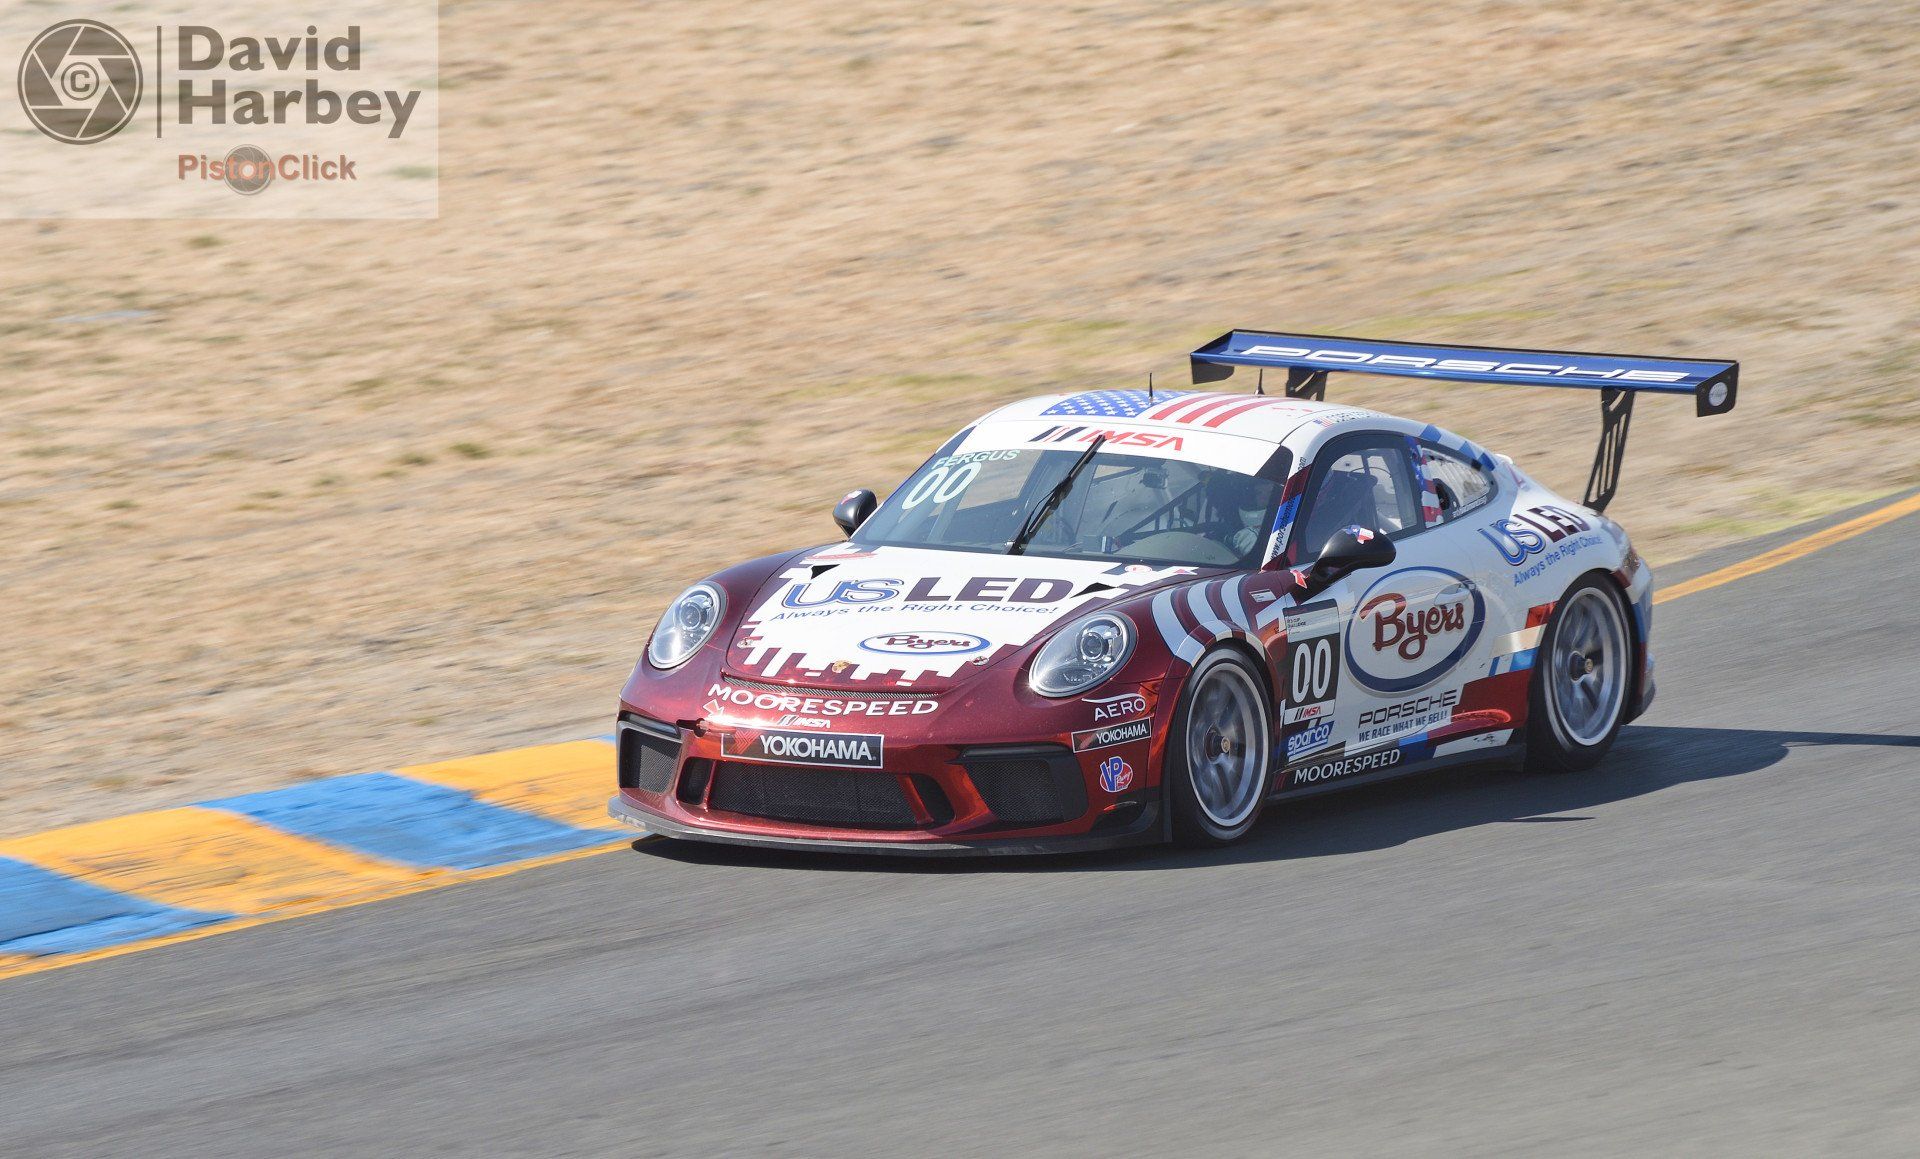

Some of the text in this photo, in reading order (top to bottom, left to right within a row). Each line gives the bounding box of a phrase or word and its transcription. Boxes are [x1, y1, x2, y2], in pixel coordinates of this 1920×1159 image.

[1239, 345, 1690, 382] PORSCHE
[1077, 428, 1185, 452] IMSA
[932, 449, 1021, 470] FERGUS
[901, 461, 982, 510] 00
[1513, 561, 1546, 587] Always
[1545, 551, 1561, 566] the
[903, 577, 1074, 604] LED
[769, 603, 1060, 621] Always the Right Choice!
[1359, 593, 1465, 660] Byers
[876, 634, 972, 650] Byers
[1292, 638, 1332, 703] 00
[707, 683, 939, 716] MOORESPEED
[1094, 697, 1146, 722] AERO
[1357, 689, 1458, 729] PORSCHE
[1095, 722, 1148, 745] YOKOHAMA
[1287, 724, 1330, 754] sparco
[1358, 730, 1371, 742] WE
[1371, 725, 1391, 738] RACE
[1392, 719, 1414, 732] WHAT
[1415, 717, 1427, 727] WE
[760, 735, 873, 761] YOKOHAMA
[1099, 755, 1124, 792] VP
[1293, 748, 1401, 785] MOORESPEED
